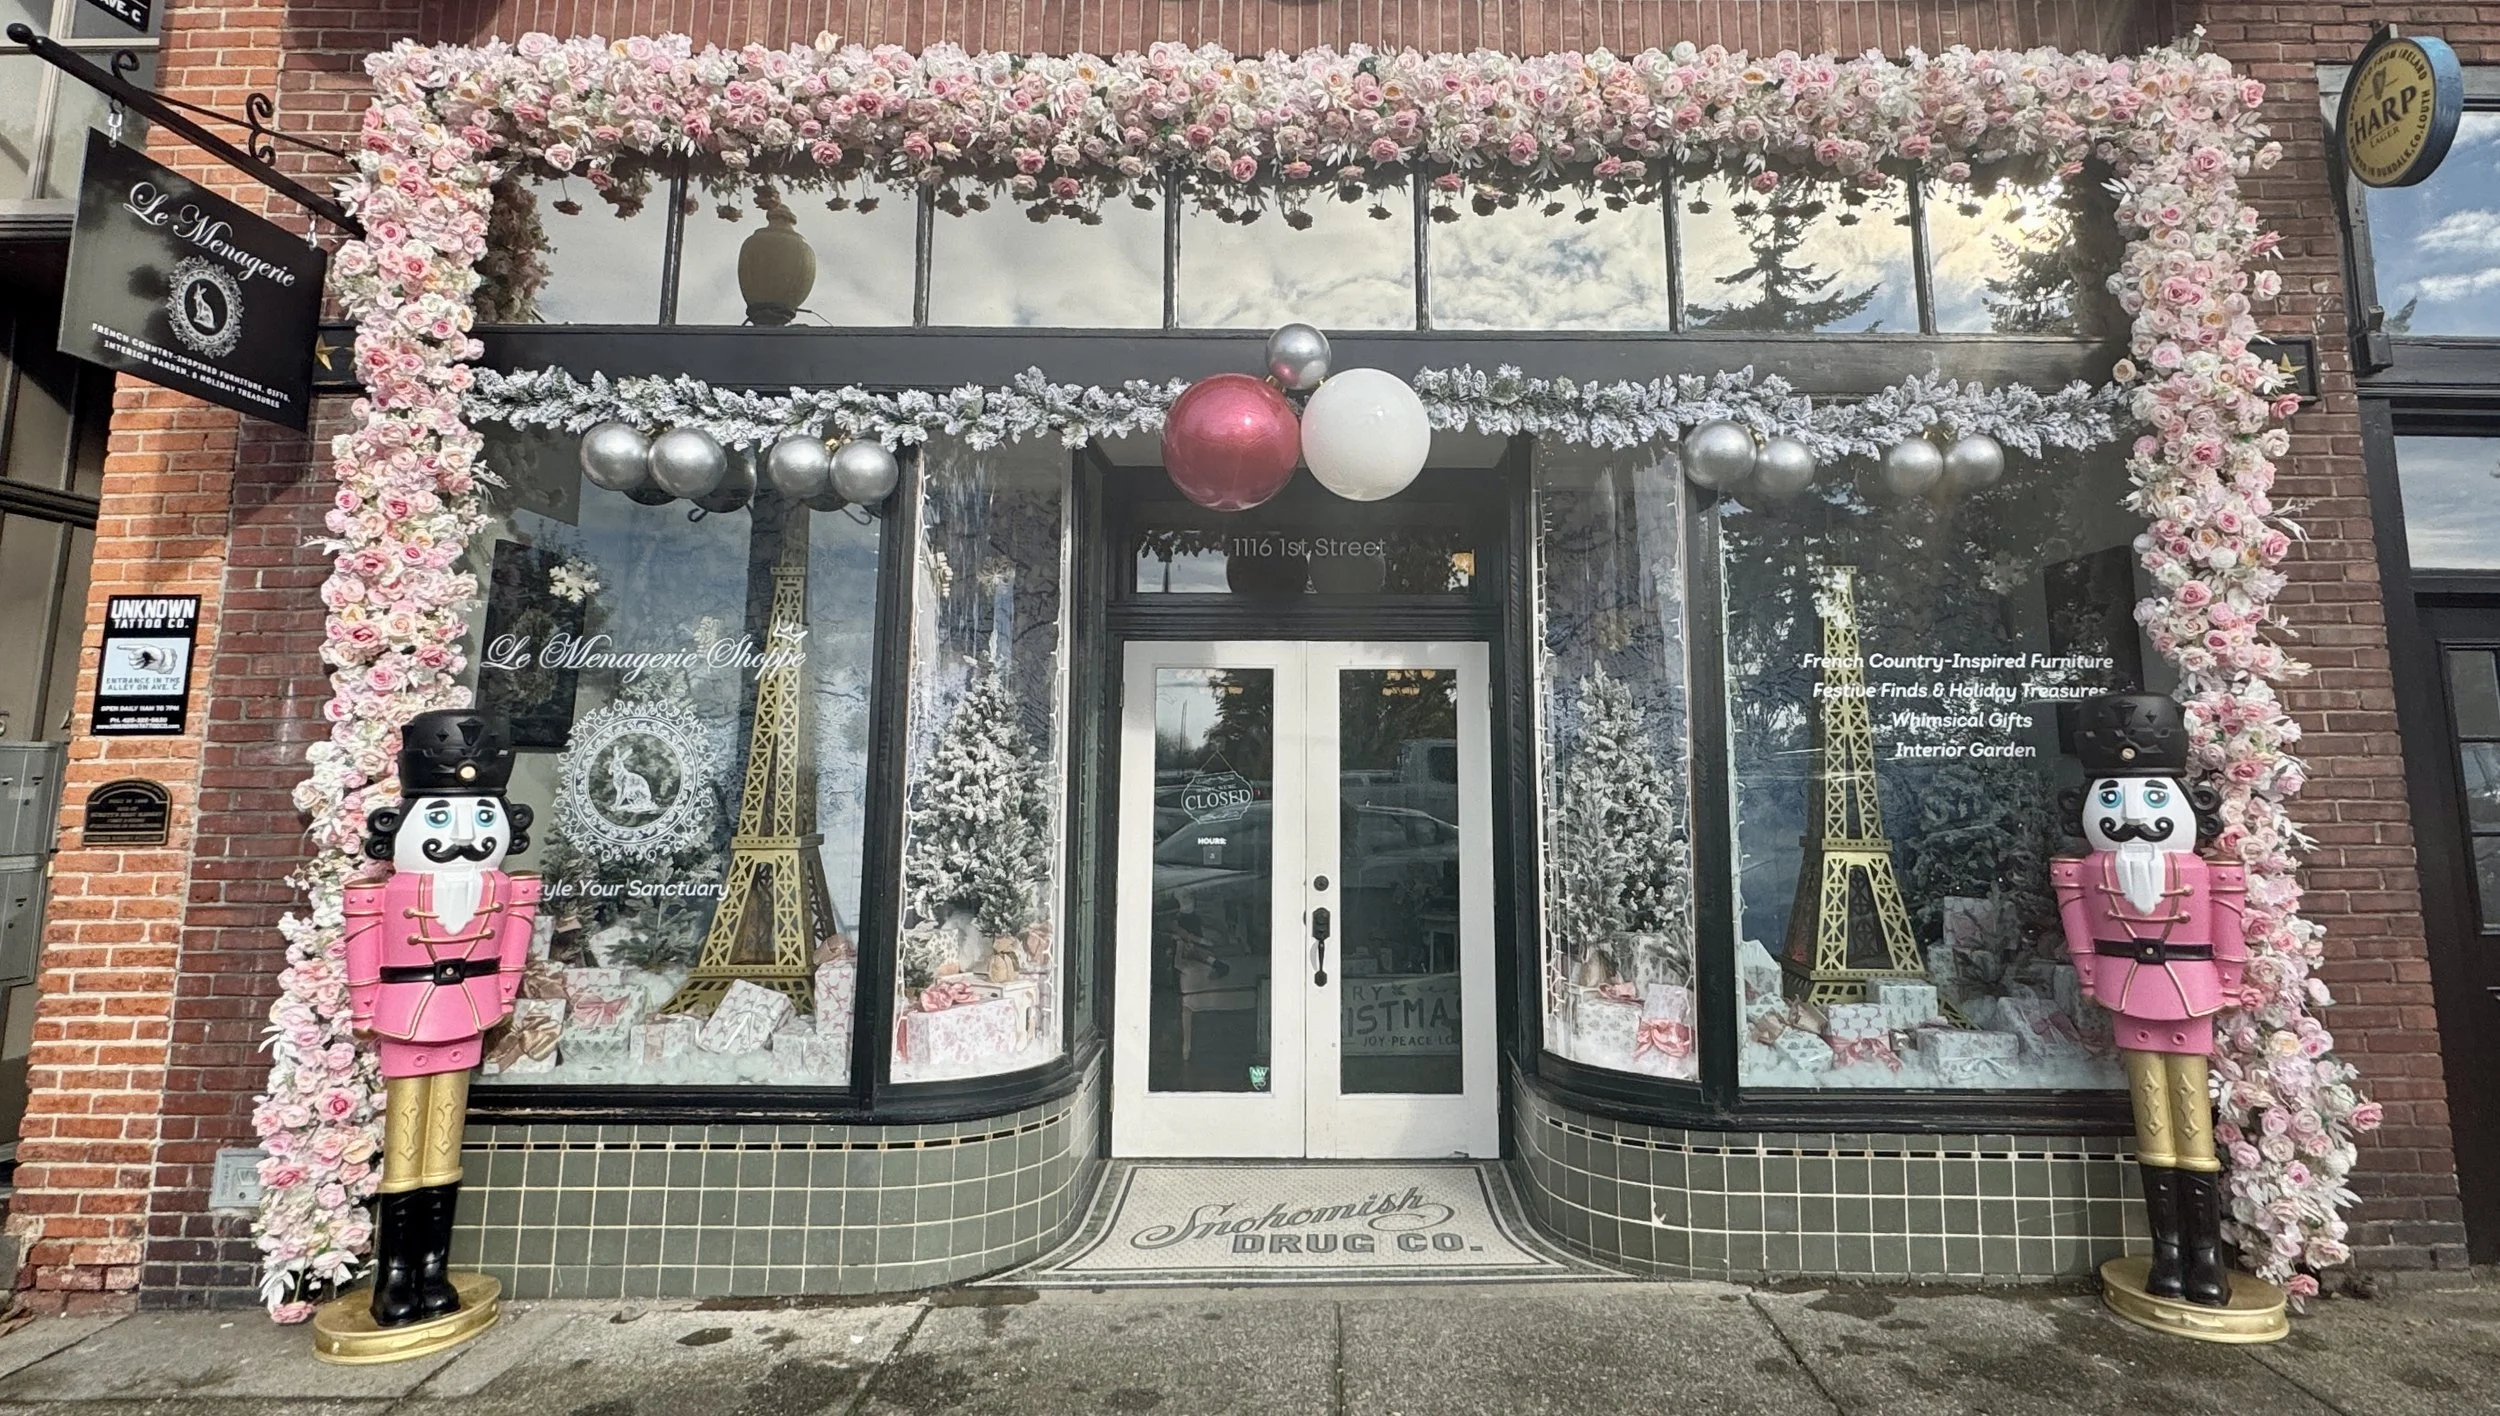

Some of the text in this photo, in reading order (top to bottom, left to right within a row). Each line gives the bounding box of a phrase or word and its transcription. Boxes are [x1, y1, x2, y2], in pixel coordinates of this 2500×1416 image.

[131, 9, 142, 22] C
[2399, 48, 2428, 80] IRELAND
[2354, 85, 2417, 145] HARP
[2370, 126, 2400, 148] LAGER
[123, 181, 296, 287] Le Menagerie
[91, 323, 130, 343] FRENCH
[131, 338, 218, 375] COUNTRY-INSPIRED
[104, 340, 149, 362] INTERIOR
[199, 373, 235, 393] HOLIDAY
[237, 387, 281, 409] TREASURES
[1233, 538, 1387, 557] 1116 1st Street
[110, 599, 196, 618] UNKNOWN
[114, 618, 189, 629] TATTOO CO.
[481, 632, 807, 684] Le Menagerie Shoppe
[1803, 652, 2114, 673] French Country-Inspired Furniture
[1813, 682, 2108, 702] Festive Finds & Holiday Treasures
[1891, 712, 2033, 732] Whimsical Gifts
[1895, 742, 2036, 758] Interior Garden
[1185, 789, 1251, 810] CLOSED
[537, 879, 731, 901] yle Your Sanctuary
[1347, 997, 1461, 1037] ISTMA
[1363, 1036, 1385, 1047] JOY
[1391, 1035, 1433, 1047] PEACE
[1130, 1187, 1456, 1250] Snohomish
[1230, 1232, 1484, 1254] DRUG CO.
